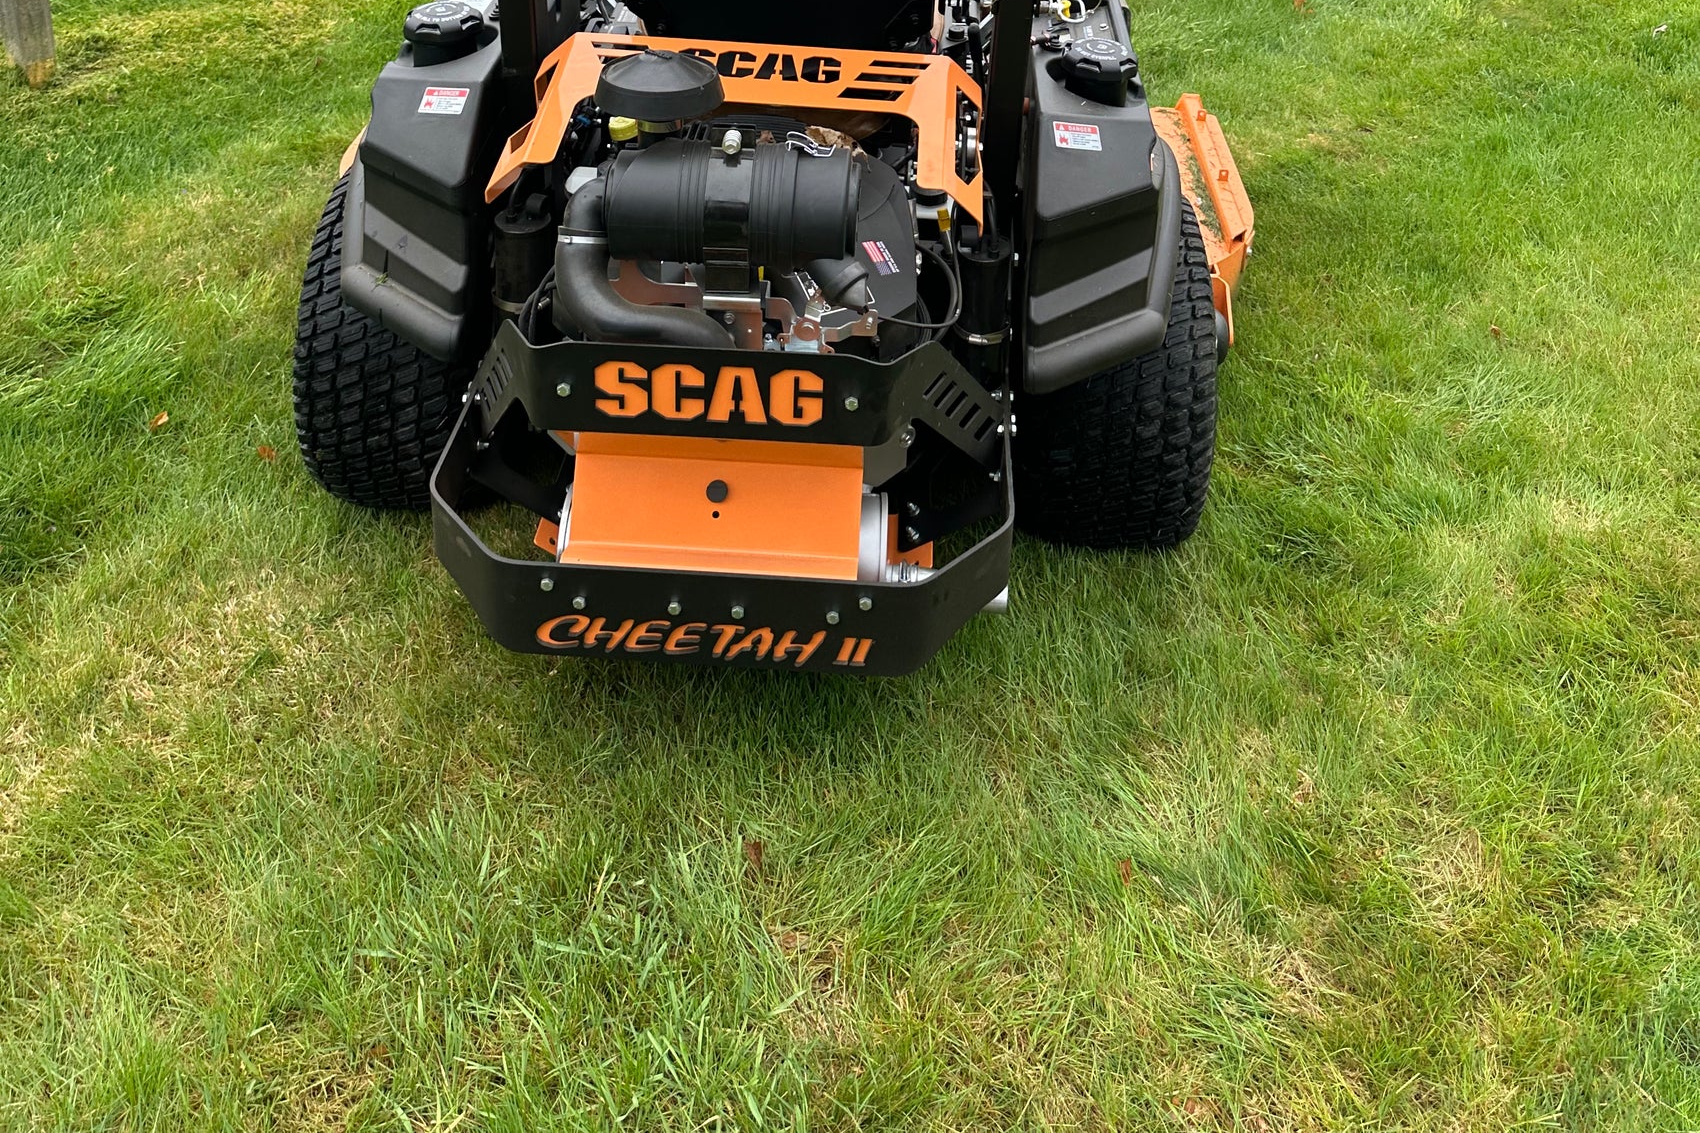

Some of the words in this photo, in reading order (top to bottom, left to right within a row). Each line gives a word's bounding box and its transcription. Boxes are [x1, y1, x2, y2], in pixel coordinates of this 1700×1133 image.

[594, 360, 824, 427] SCAG
[536, 614, 827, 667] CHEETAH
[832, 637, 873, 667] II
